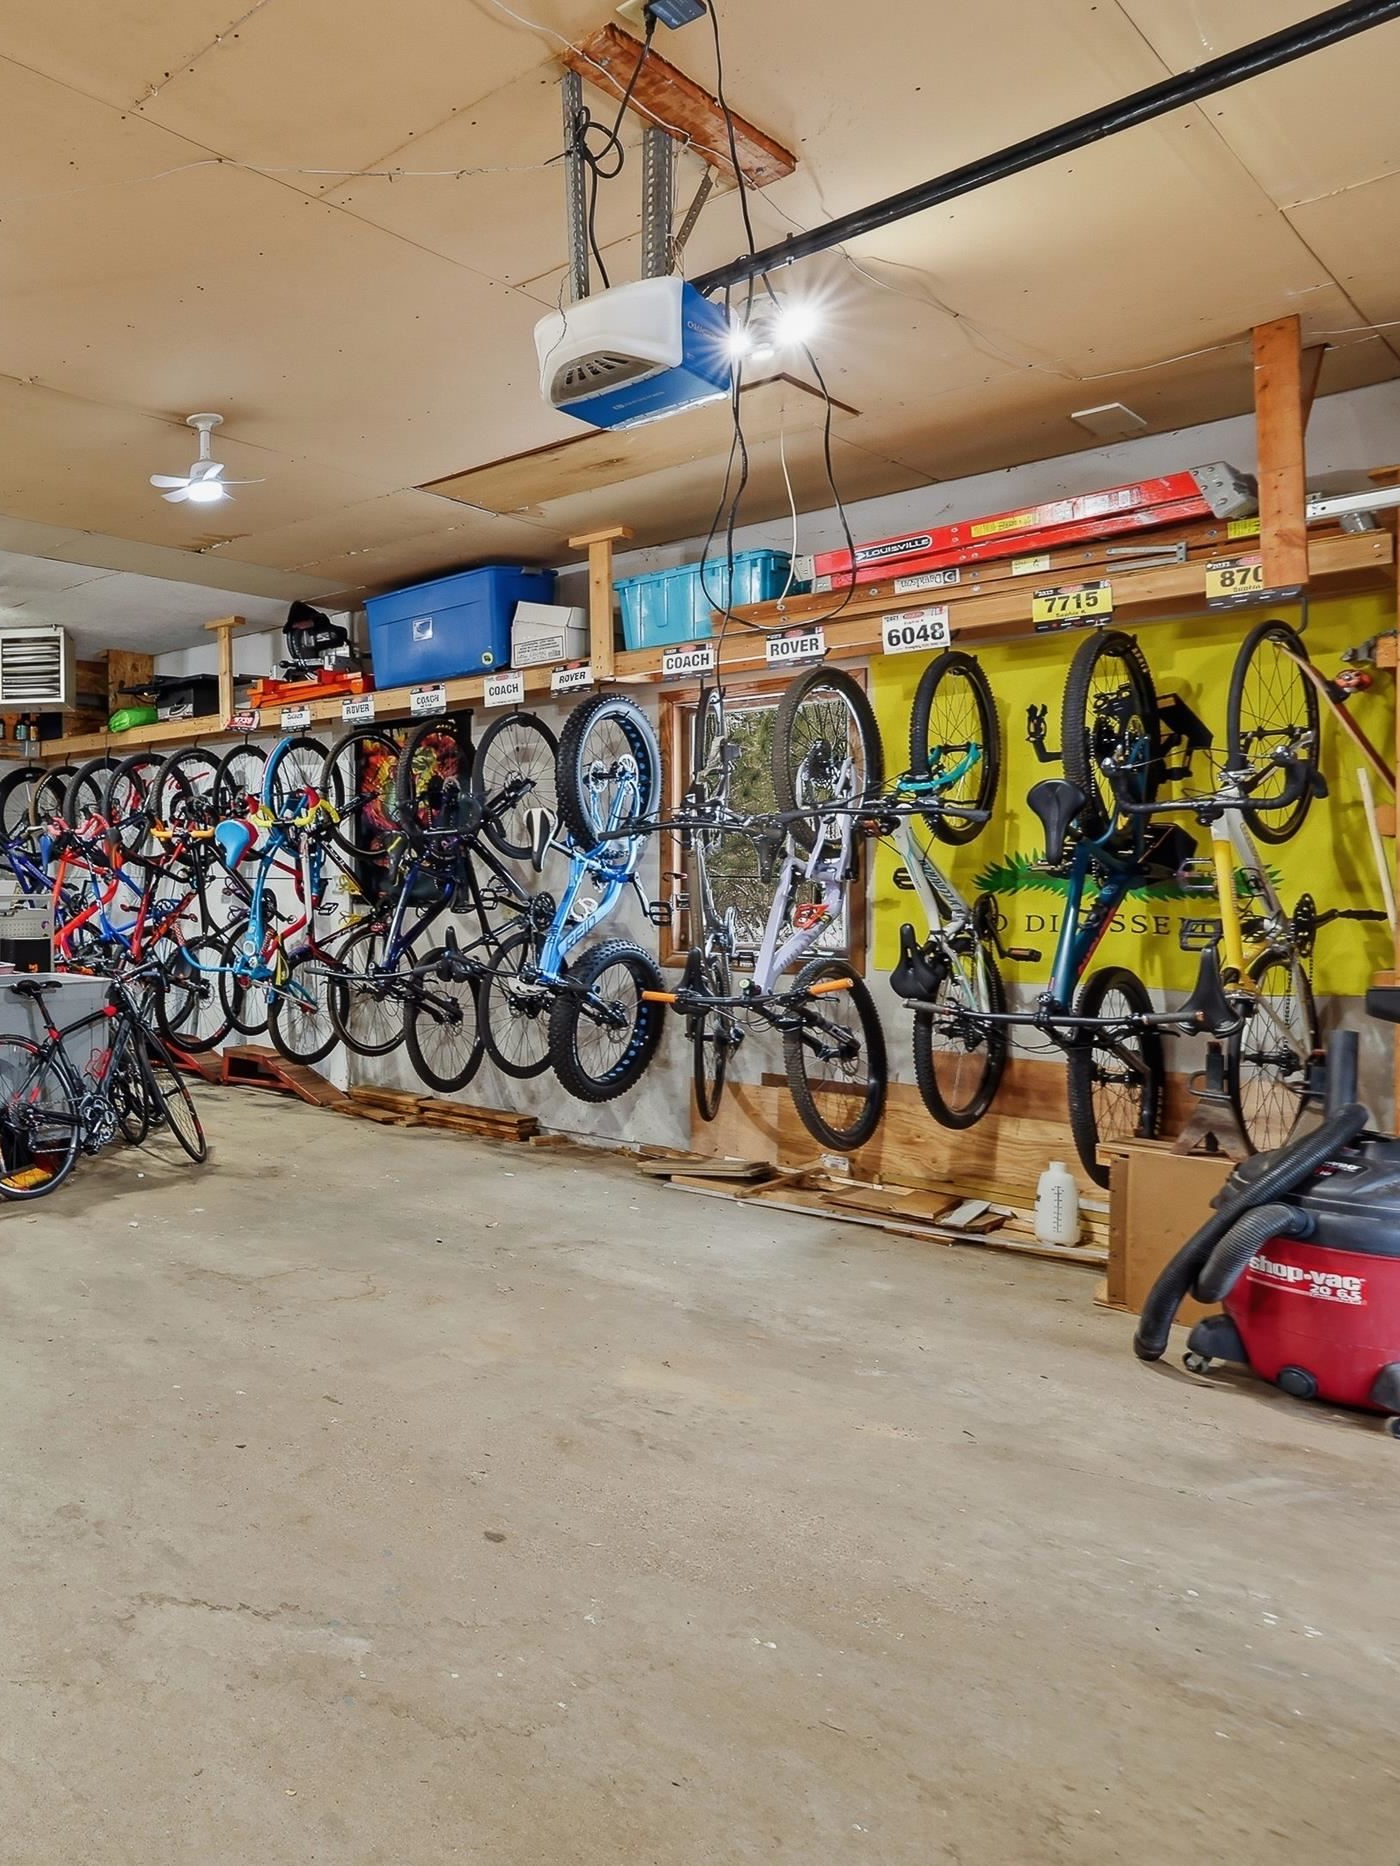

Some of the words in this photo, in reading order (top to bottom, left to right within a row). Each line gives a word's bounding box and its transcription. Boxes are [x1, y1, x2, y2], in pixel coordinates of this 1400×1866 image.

[865, 538, 929, 558] LOUISVILLE
[1044, 592, 1098, 613] 7715
[888, 622, 945, 646] 6048
[770, 638, 819, 656] ROVER
[666, 653, 710, 670] COACH
[559, 671, 586, 684] ROVER
[488, 683, 519, 697] COACH
[346, 703, 370, 715] ROVER
